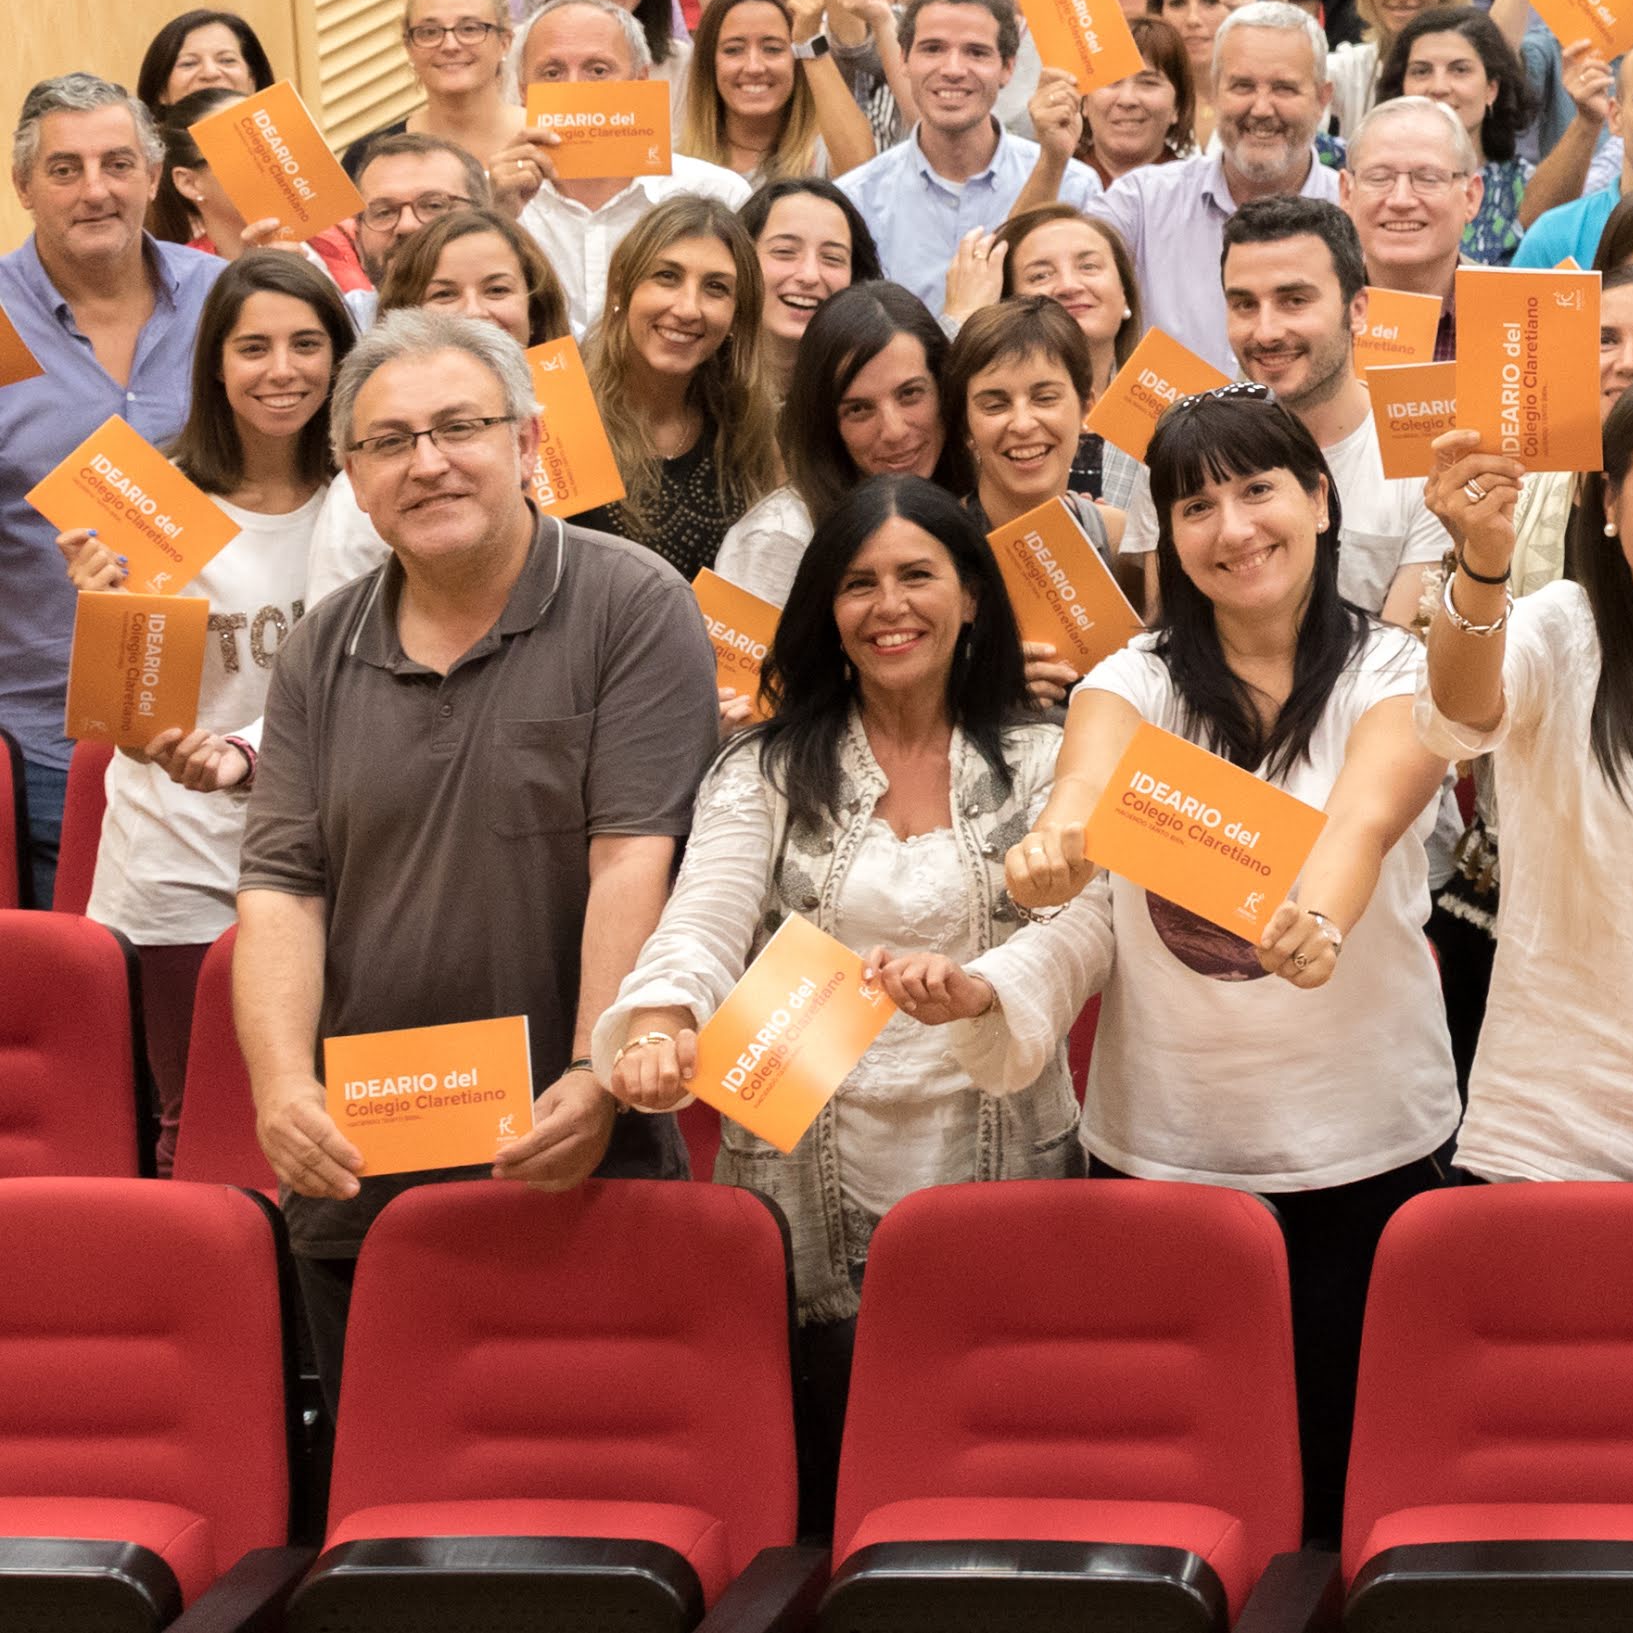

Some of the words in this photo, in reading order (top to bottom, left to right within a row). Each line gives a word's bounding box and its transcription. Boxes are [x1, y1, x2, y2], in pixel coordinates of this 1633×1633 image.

[1596, 6, 1617, 27] del
[250, 109, 298, 174] IDEARIO
[291, 177, 317, 202] del
[537, 113, 605, 128] IDEARIO
[610, 112, 635, 126] del
[240, 118, 271, 163] Colegio
[268, 164, 308, 224] Claretiano
[1372, 324, 1399, 341] del
[1502, 321, 1522, 357] del
[1522, 295, 1540, 388] Claretiano
[1501, 362, 1521, 460] IDEARIO
[1522, 393, 1541, 461] Colegio
[79, 468, 123, 510] Colegio
[124, 508, 183, 564] Claretiano
[88, 453, 156, 515] IDEARIO
[153, 515, 185, 540] del
[1012, 539, 1046, 588] Colegio
[1043, 590, 1088, 656] Claretiano
[1022, 529, 1075, 601] IDEARIO
[1069, 604, 1096, 632] del
[125, 613, 145, 663] Colegio
[140, 614, 165, 686] IDEARIO
[118, 666, 139, 735] Claretiano
[136, 690, 156, 717] del
[1121, 791, 1183, 832] Colegio
[1187, 825, 1271, 877] Claretiano
[1127, 770, 1221, 828] IDEARIO
[1223, 821, 1262, 850] del
[720, 1006, 791, 1094] IDEARIO
[788, 976, 817, 1026] del
[739, 1042, 788, 1103] Colegio
[784, 969, 846, 1049] Claretiano
[343, 1073, 438, 1101] IDEARIO
[443, 1068, 478, 1090] del
[345, 1098, 411, 1118] Colegio
[415, 1090, 505, 1110] Claretiano
